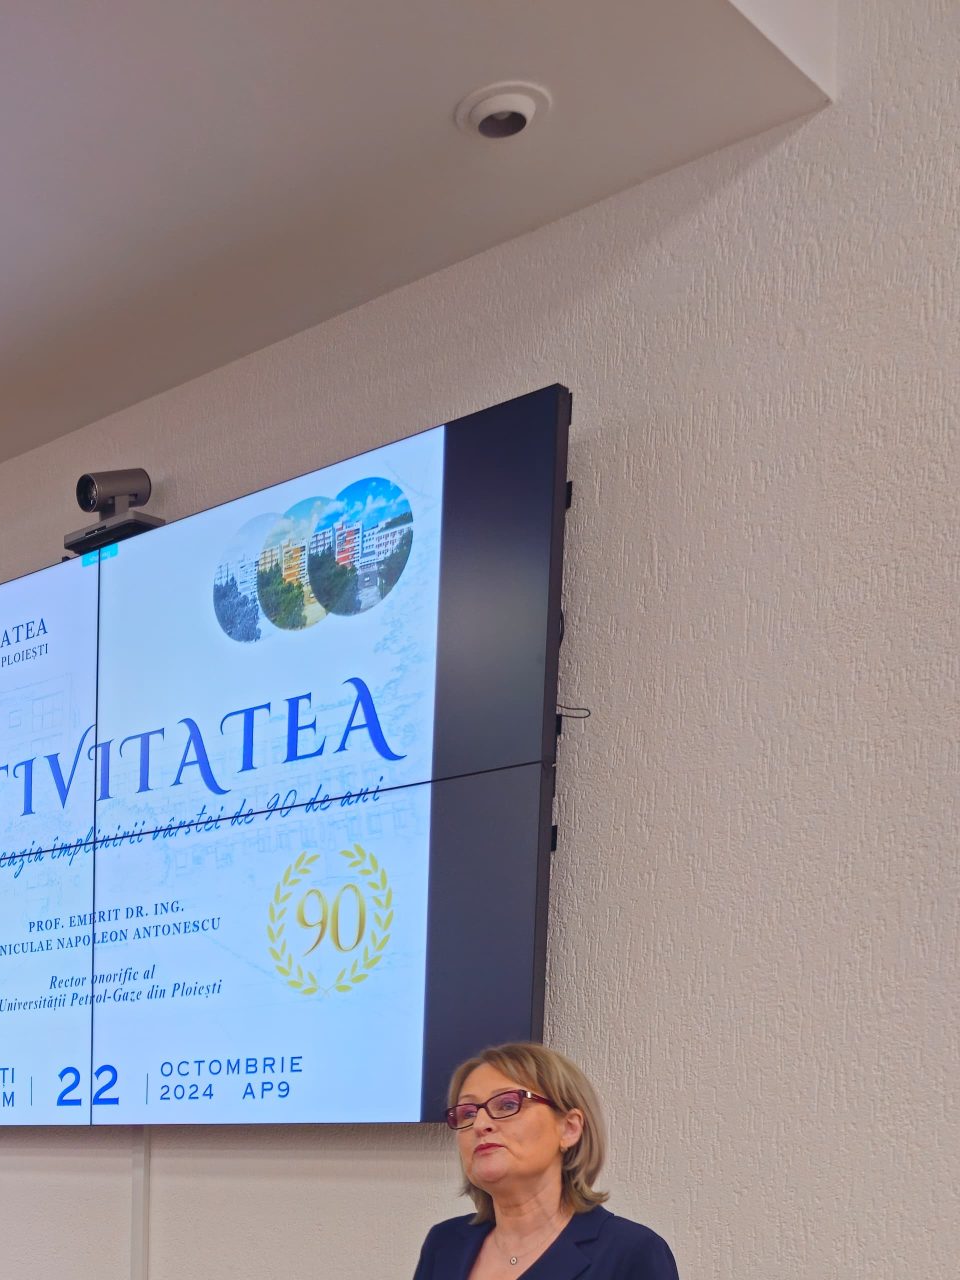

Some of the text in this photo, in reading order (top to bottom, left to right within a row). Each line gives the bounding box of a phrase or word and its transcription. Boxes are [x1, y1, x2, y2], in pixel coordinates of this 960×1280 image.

[230, 799, 255, 827] de
[265, 789, 297, 821] 90
[305, 784, 330, 811] de
[340, 775, 384, 805] ani
[28, 900, 184, 932] PROF. EMERIT DR. ING.
[296, 883, 366, 957] 90
[0, 917, 221, 956] NICULAE NAPOLEON ANTONESCU
[49, 964, 156, 990] Rector onorific al
[70, 988, 142, 1007] Petrol-Gaze
[147, 984, 166, 1000] din
[160, 1055, 303, 1077] OCTOMBRIE
[56, 1064, 119, 1106] 22
[160, 1081, 290, 1101] 2024 AP9
